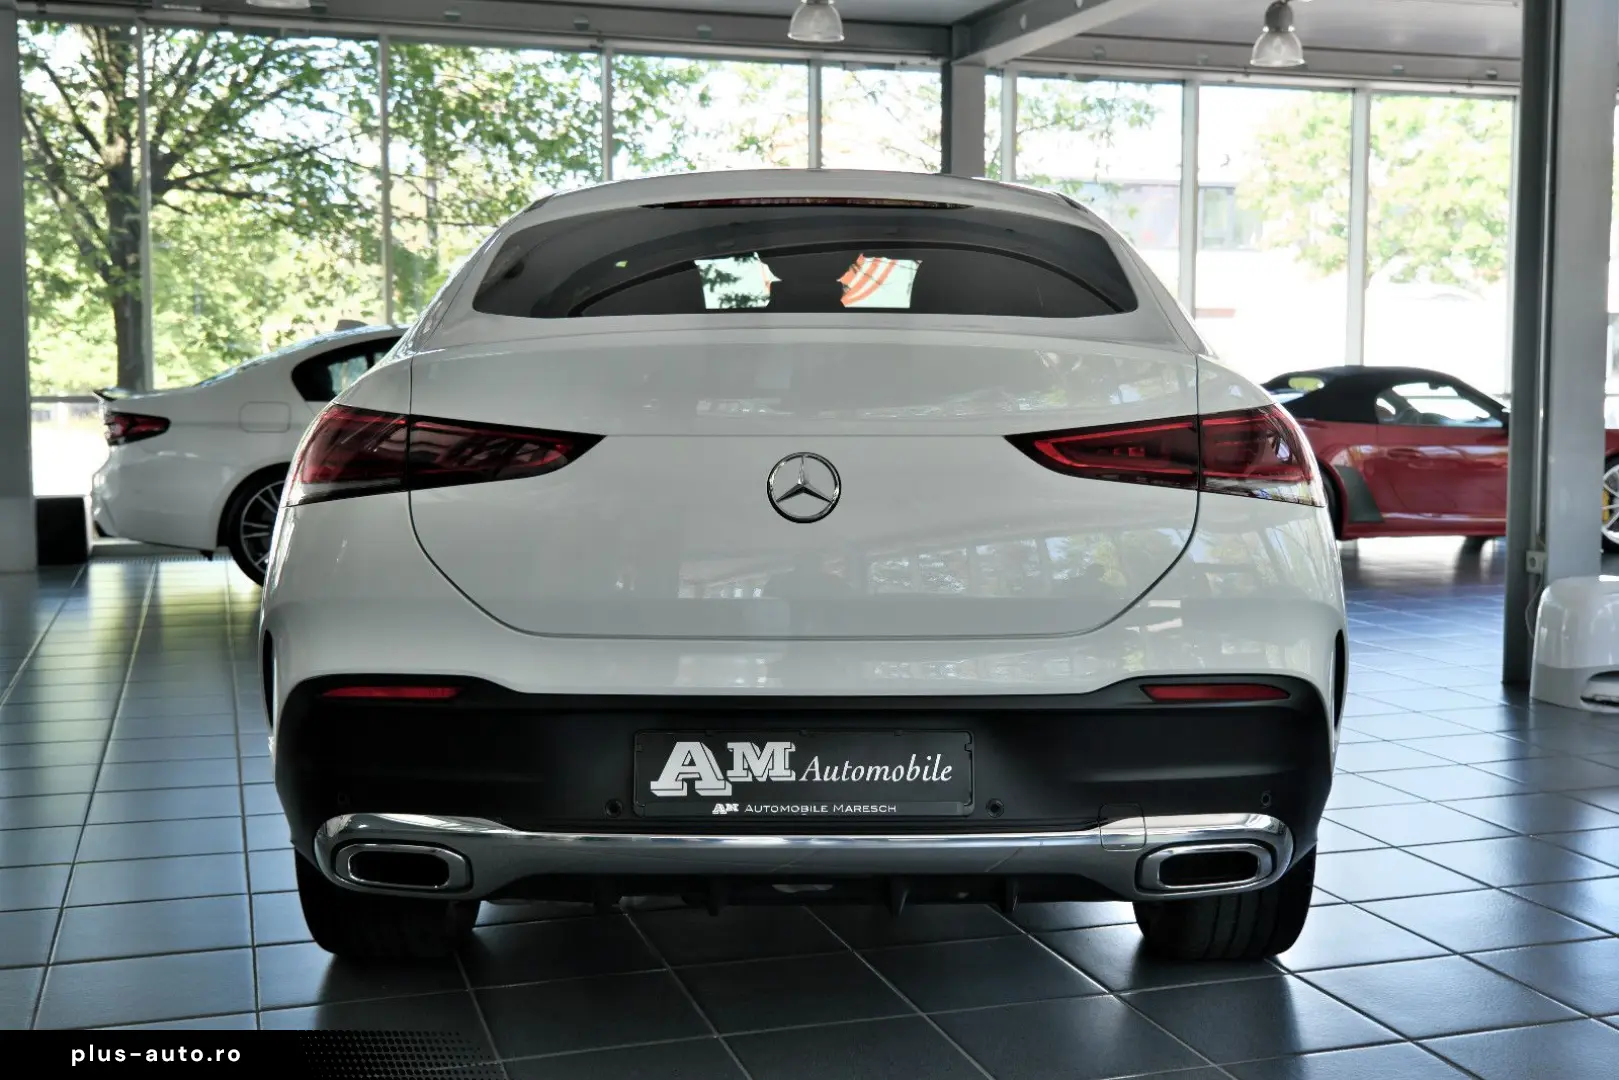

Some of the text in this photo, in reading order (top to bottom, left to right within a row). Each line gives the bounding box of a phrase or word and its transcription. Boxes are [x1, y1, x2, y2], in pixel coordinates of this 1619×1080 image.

[650, 741, 952, 797] AM Automobile
[744, 803, 828, 814] AUTOMOBILE
[832, 803, 897, 814] MARESCH
